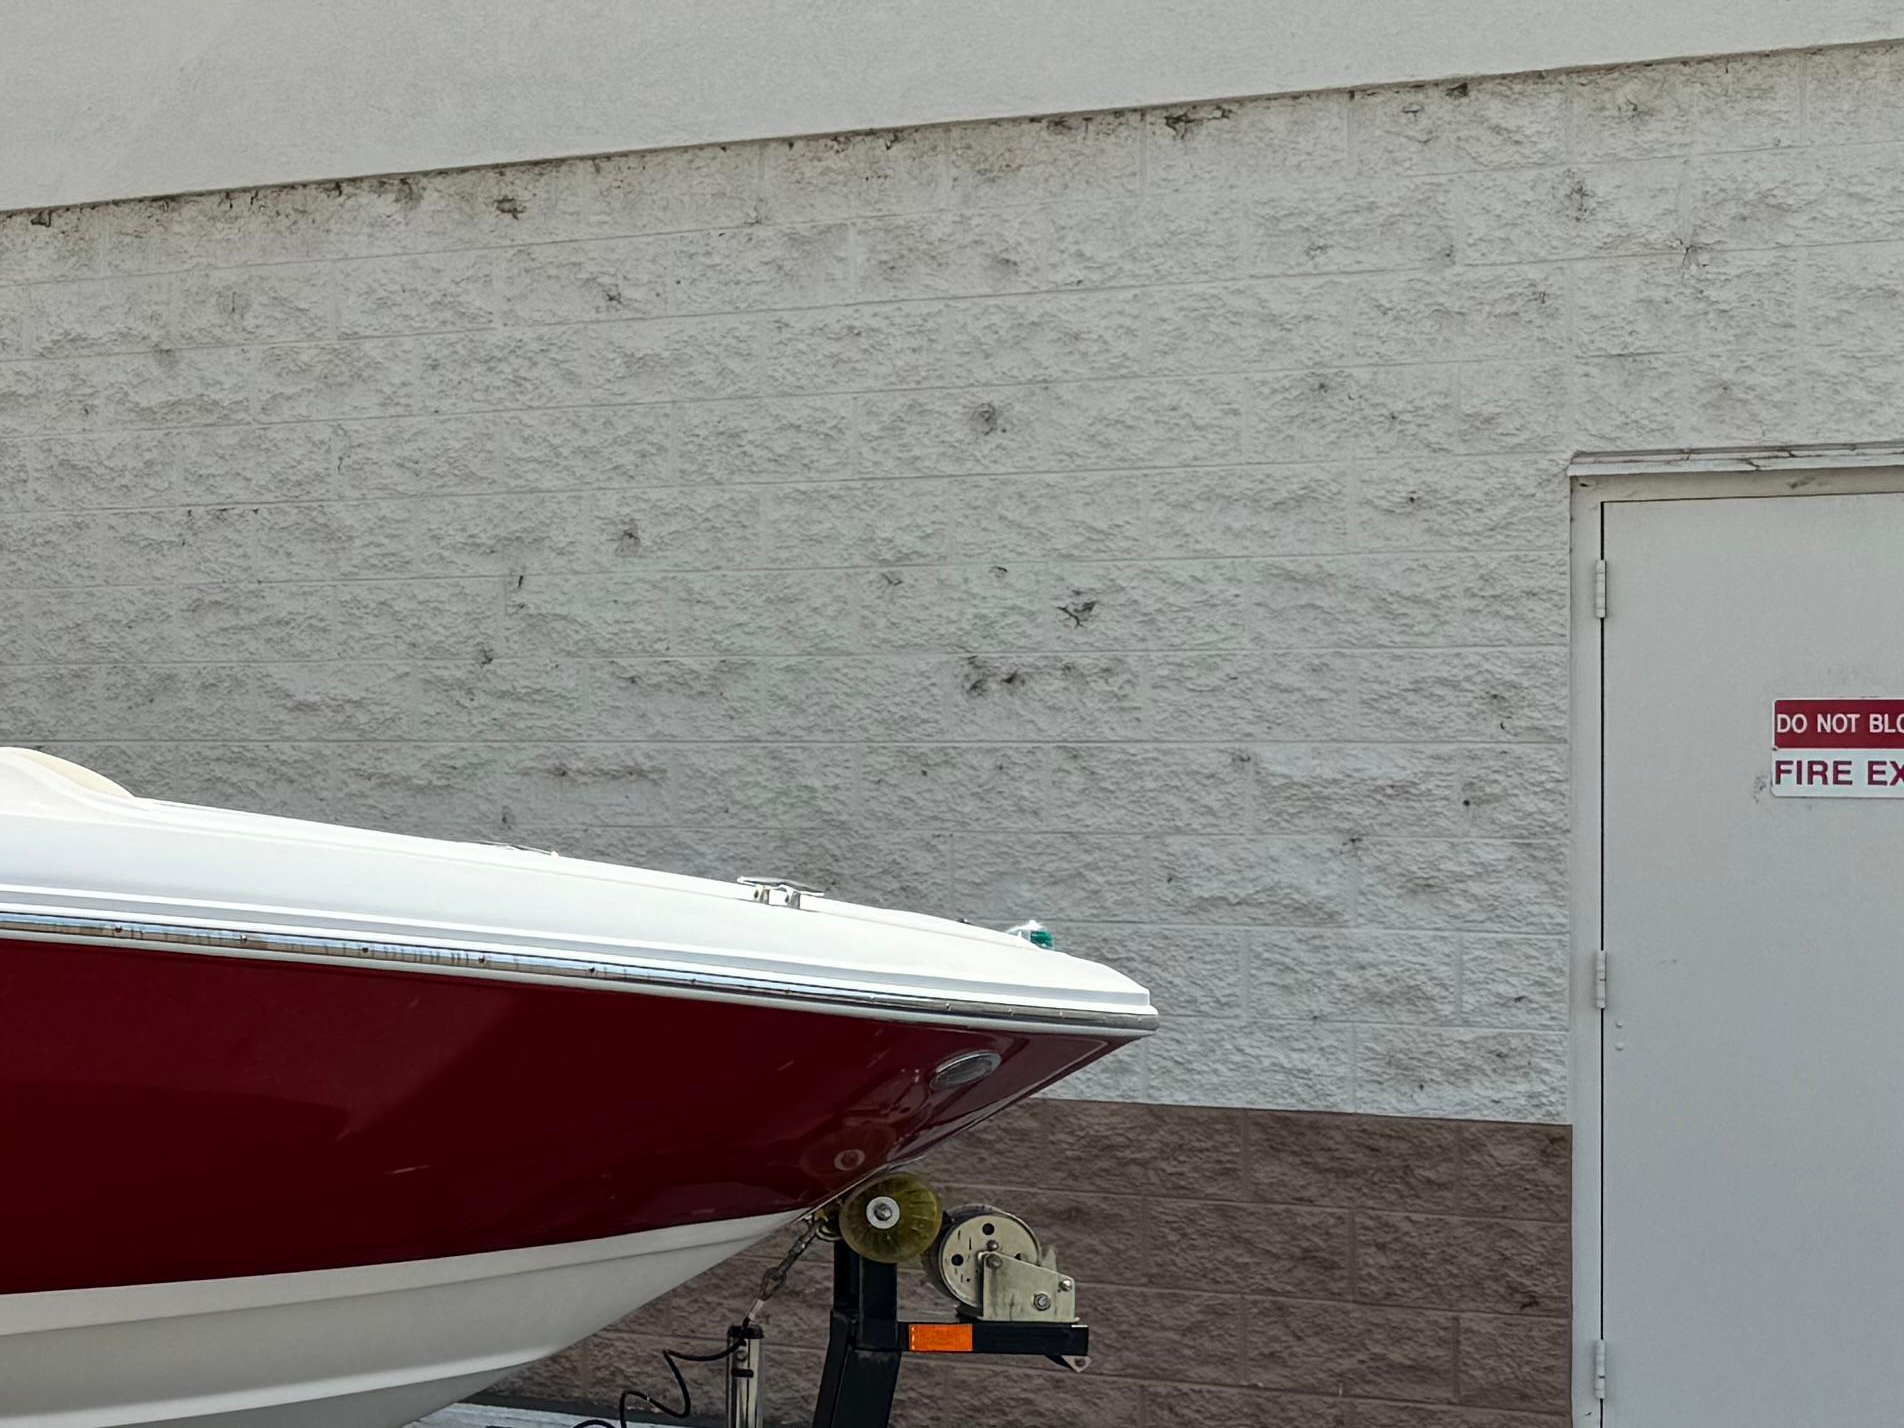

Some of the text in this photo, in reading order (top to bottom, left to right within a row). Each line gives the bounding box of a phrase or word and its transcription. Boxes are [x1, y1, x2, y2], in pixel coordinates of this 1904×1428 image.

[1776, 713, 1808, 734] DO
[1817, 713, 1861, 734] NOT
[1775, 760, 1904, 786] FIRE EX
